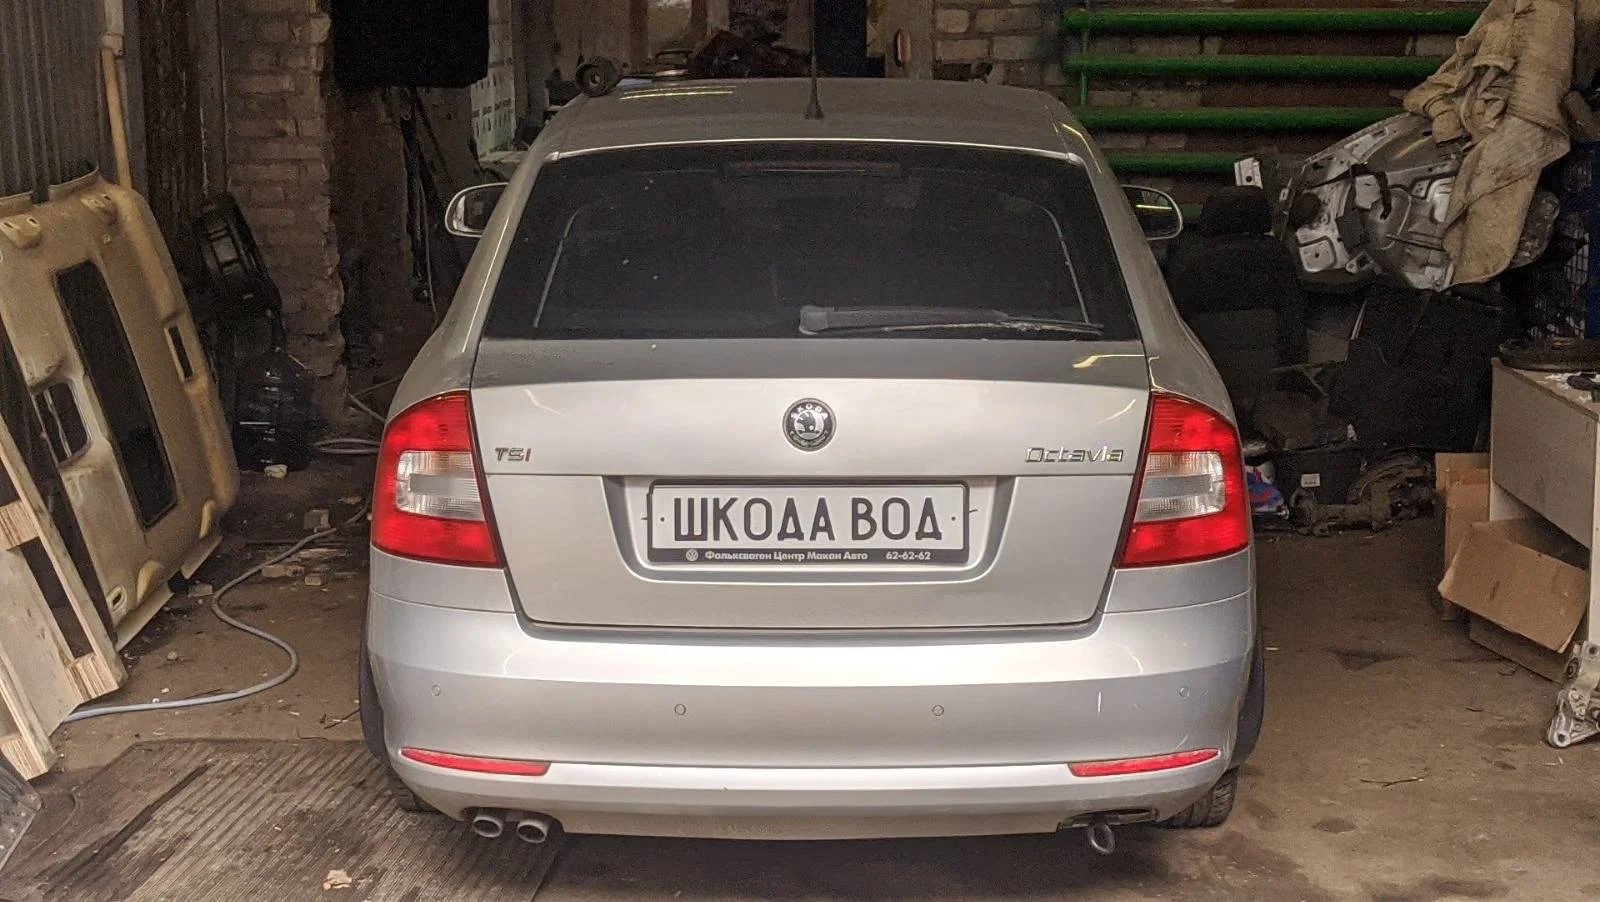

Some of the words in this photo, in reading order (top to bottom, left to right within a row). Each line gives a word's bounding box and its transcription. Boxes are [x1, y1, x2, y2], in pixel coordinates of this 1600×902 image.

[494, 447, 532, 462] TSI
[1025, 446, 1124, 462] Octavia
[674, 497, 836, 541] ШКОДА
[851, 497, 943, 541] ВОД
[705, 550, 772, 560] Фольксваген
[773, 551, 805, 562] Центр
[843, 551, 868, 560] Авто
[886, 551, 931, 560] 62-62-62
